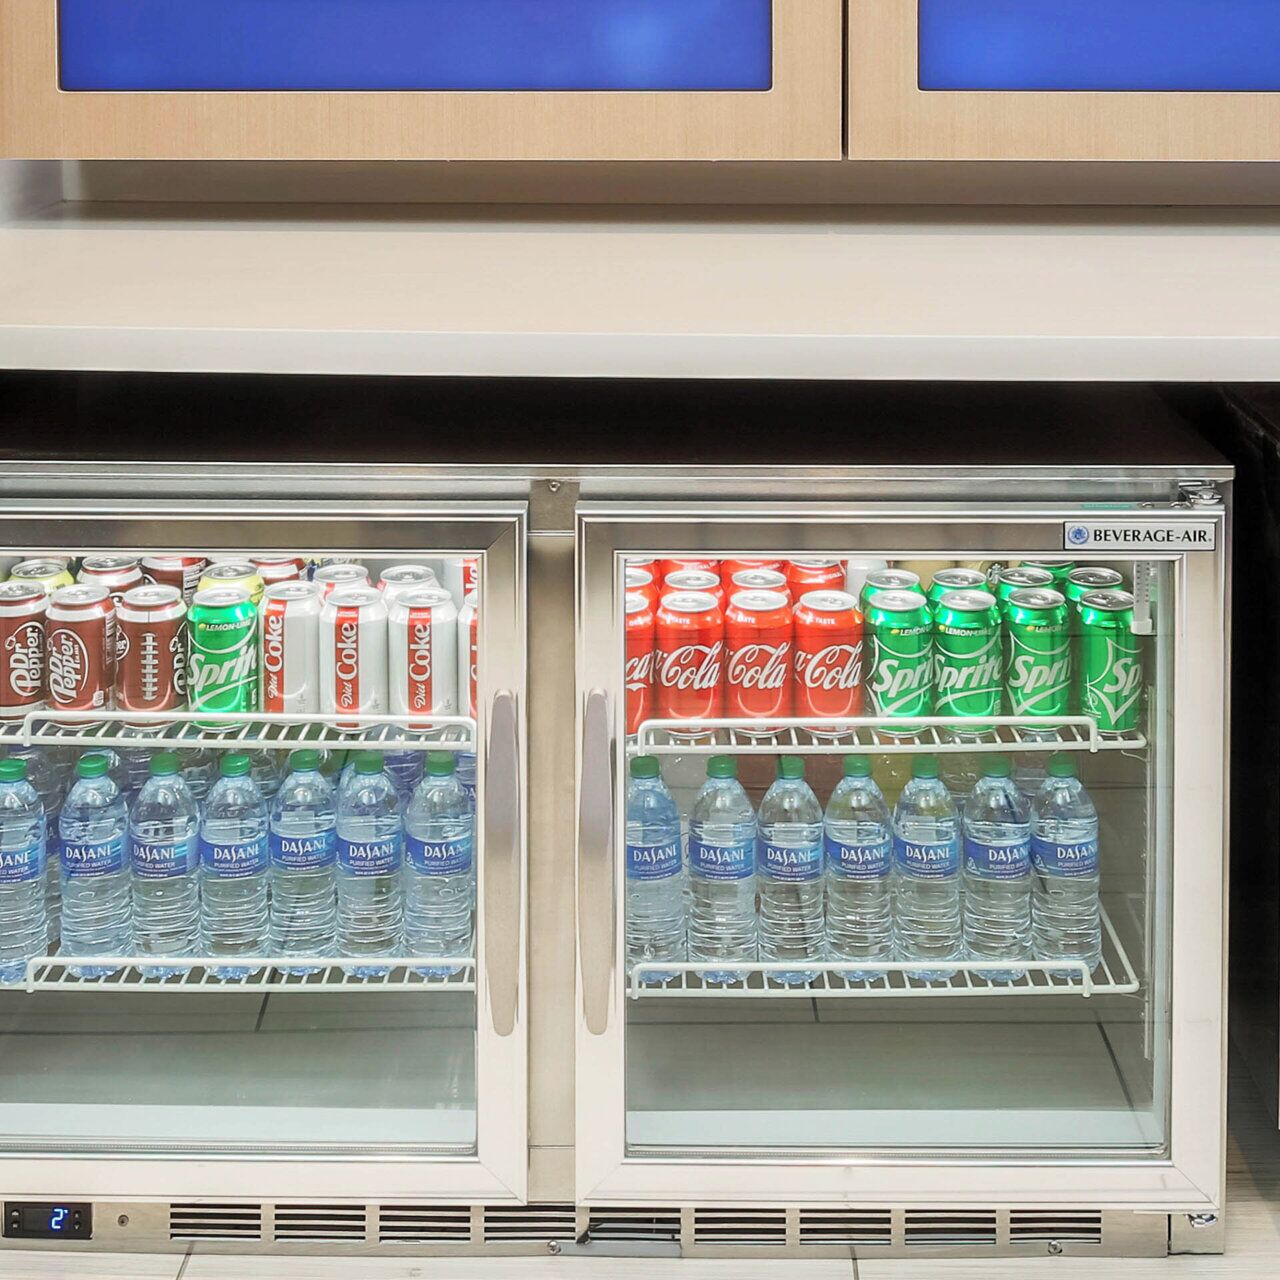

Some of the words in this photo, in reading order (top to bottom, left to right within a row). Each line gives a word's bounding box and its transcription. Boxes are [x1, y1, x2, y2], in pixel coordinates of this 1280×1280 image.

[1093, 529, 1208, 543] BEVERAGE-AIR
[815, 617, 836, 625] TASTE
[264, 615, 284, 673] Coke
[336, 620, 358, 681] Coke
[409, 622, 431, 682] Coke
[66, 844, 111, 865] DASANI
[133, 844, 176, 865] DASANI
[214, 844, 259, 865] DASANI
[281, 837, 326, 856] DASANI
[349, 842, 393, 863] DASANI
[633, 844, 677, 865] DASANI
[700, 846, 744, 864] DASANI
[767, 846, 811, 865] DASANI
[841, 845, 884, 864] DASANI
[906, 844, 949, 863] DASANI
